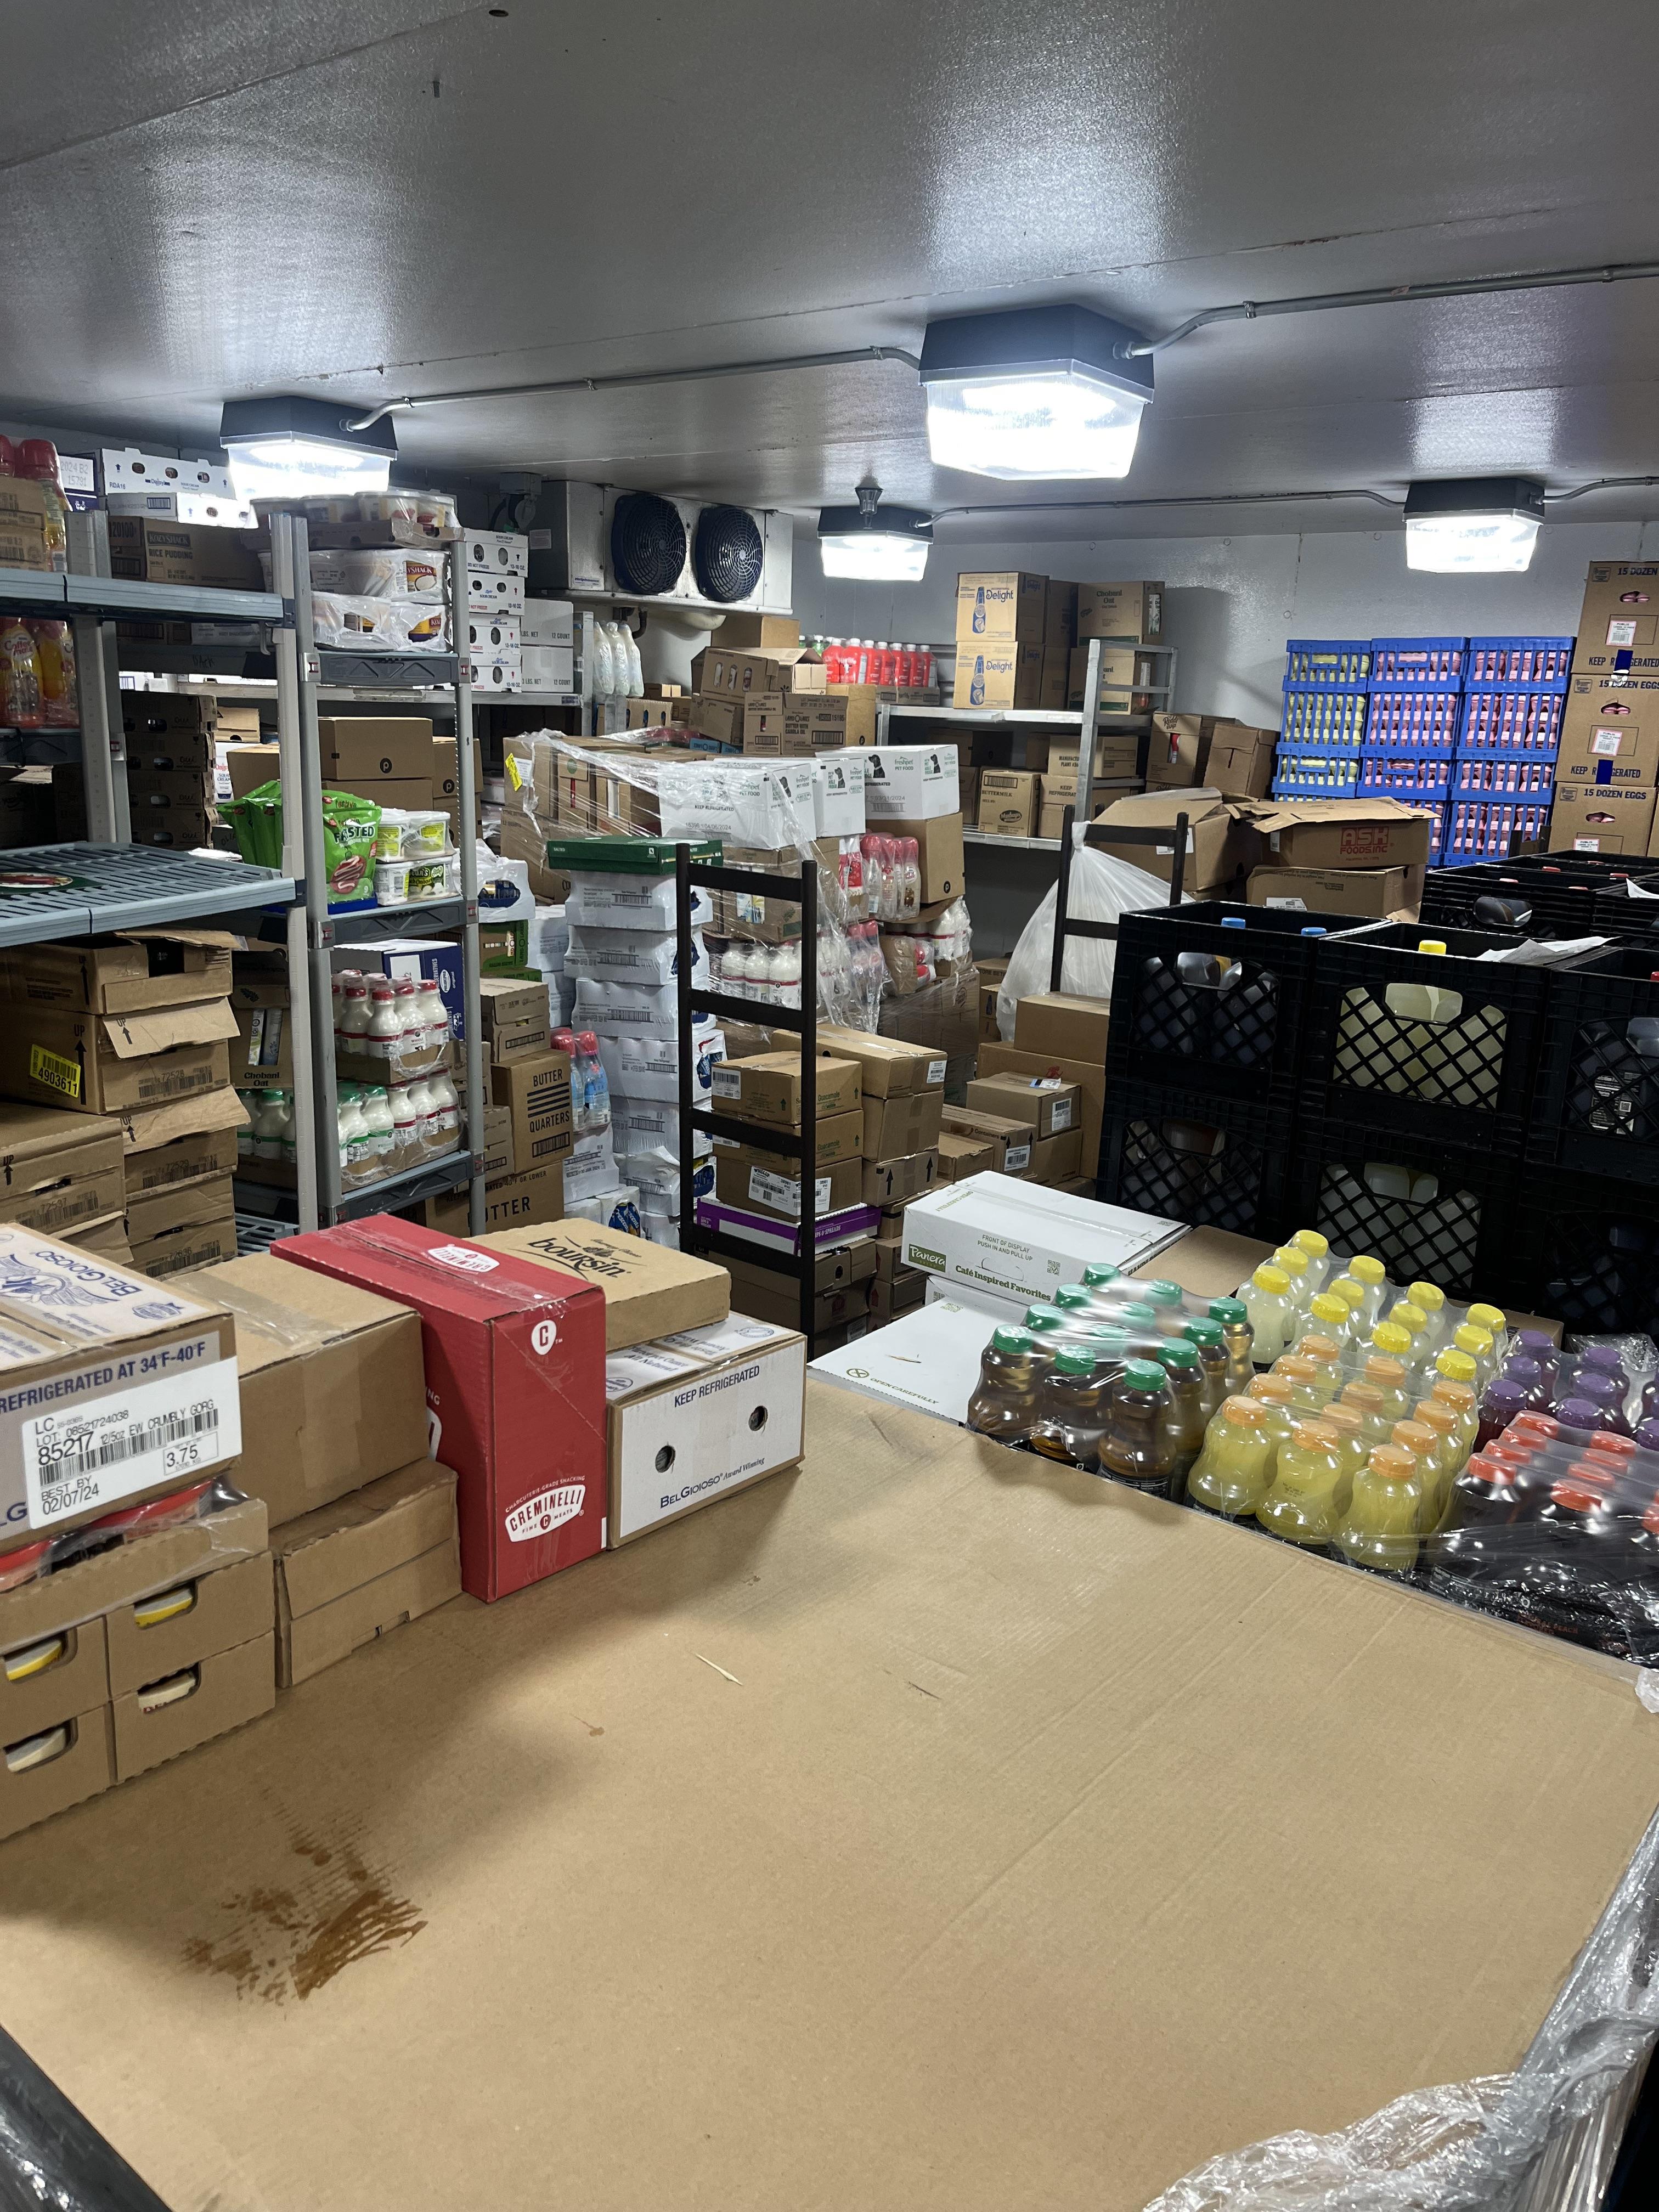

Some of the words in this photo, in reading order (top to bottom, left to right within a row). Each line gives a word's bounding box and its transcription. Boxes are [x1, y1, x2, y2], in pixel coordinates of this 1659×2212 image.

[149, 549, 163, 558] RICE
[165, 550, 193, 560] PUDDING
[1618, 567, 1628, 575] 15
[986, 590, 1014, 602] Delight
[986, 661, 1012, 673] Delight
[1589, 657, 1606, 665] KEEP
[1610, 657, 1659, 667] RGERATED
[1599, 680, 1609, 688] 15
[1571, 765, 1588, 775] KEEP
[1592, 767, 1641, 778] RGERATED
[1596, 789, 1622, 798] DOZEN
[1342, 828, 1389, 845] ASK
[74, 1025, 85, 1037] UP
[116, 1018, 126, 1028] UP
[38, 1067, 78, 1095] 4903611
[533, 1069, 562, 1087] BUTTER
[122, 1115, 132, 1125] UP
[530, 1110, 569, 1133] QUARTERS
[974, 1128, 1000, 1139] Containers
[3, 1154, 14, 1165] UP
[485, 1182, 503, 1191] RATED
[529, 1170, 546, 1181] LOWER
[825, 1225, 841, 1236] SPREADS
[977, 1240, 991, 1249] PUSH
[998, 1246, 1010, 1255] AND
[1011, 1250, 1024, 1260] PULL
[982, 1234, 998, 1244] FRONT
[1008, 1242, 1030, 1254] DISPLAY
[910, 1245, 945, 1265] Panera
[956, 1265, 974, 1277] Café
[974, 1271, 1010, 1290] Inspired
[1010, 1283, 1051, 1301] Favorites
[539, 1325, 549, 1347] C
[0, 1368, 113, 1414] REFRIGERATED
[117, 1361, 136, 1380] AT
[675, 1389, 697, 1408] KEEP
[698, 1365, 760, 1398] REFRIGERATED
[871, 1378, 891, 1387] OPEN
[891, 1386, 939, 1404] CAREFULLY
[35, 1417, 55, 1435] LC
[37, 1431, 94, 1466] 85217
[129, 1423, 144, 1436] EW
[148, 1408, 187, 1430] CRUMBLY
[190, 1399, 214, 1416] GORG
[36, 1433, 61, 1448] LOT:
[166, 1443, 198, 1468] 3.75
[723, 1466, 741, 1481] Award
[742, 1458, 765, 1471] Winning
[41, 1483, 70, 1502] BEST
[77, 1475, 92, 1489] BY
[559, 1475, 585, 1485] SNACKING
[42, 1482, 99, 1515] 02/07/24
[509, 1489, 582, 1532] CREMINELLI
[522, 1523, 538, 1534] FINE
[554, 1508, 573, 1521] MEATS
